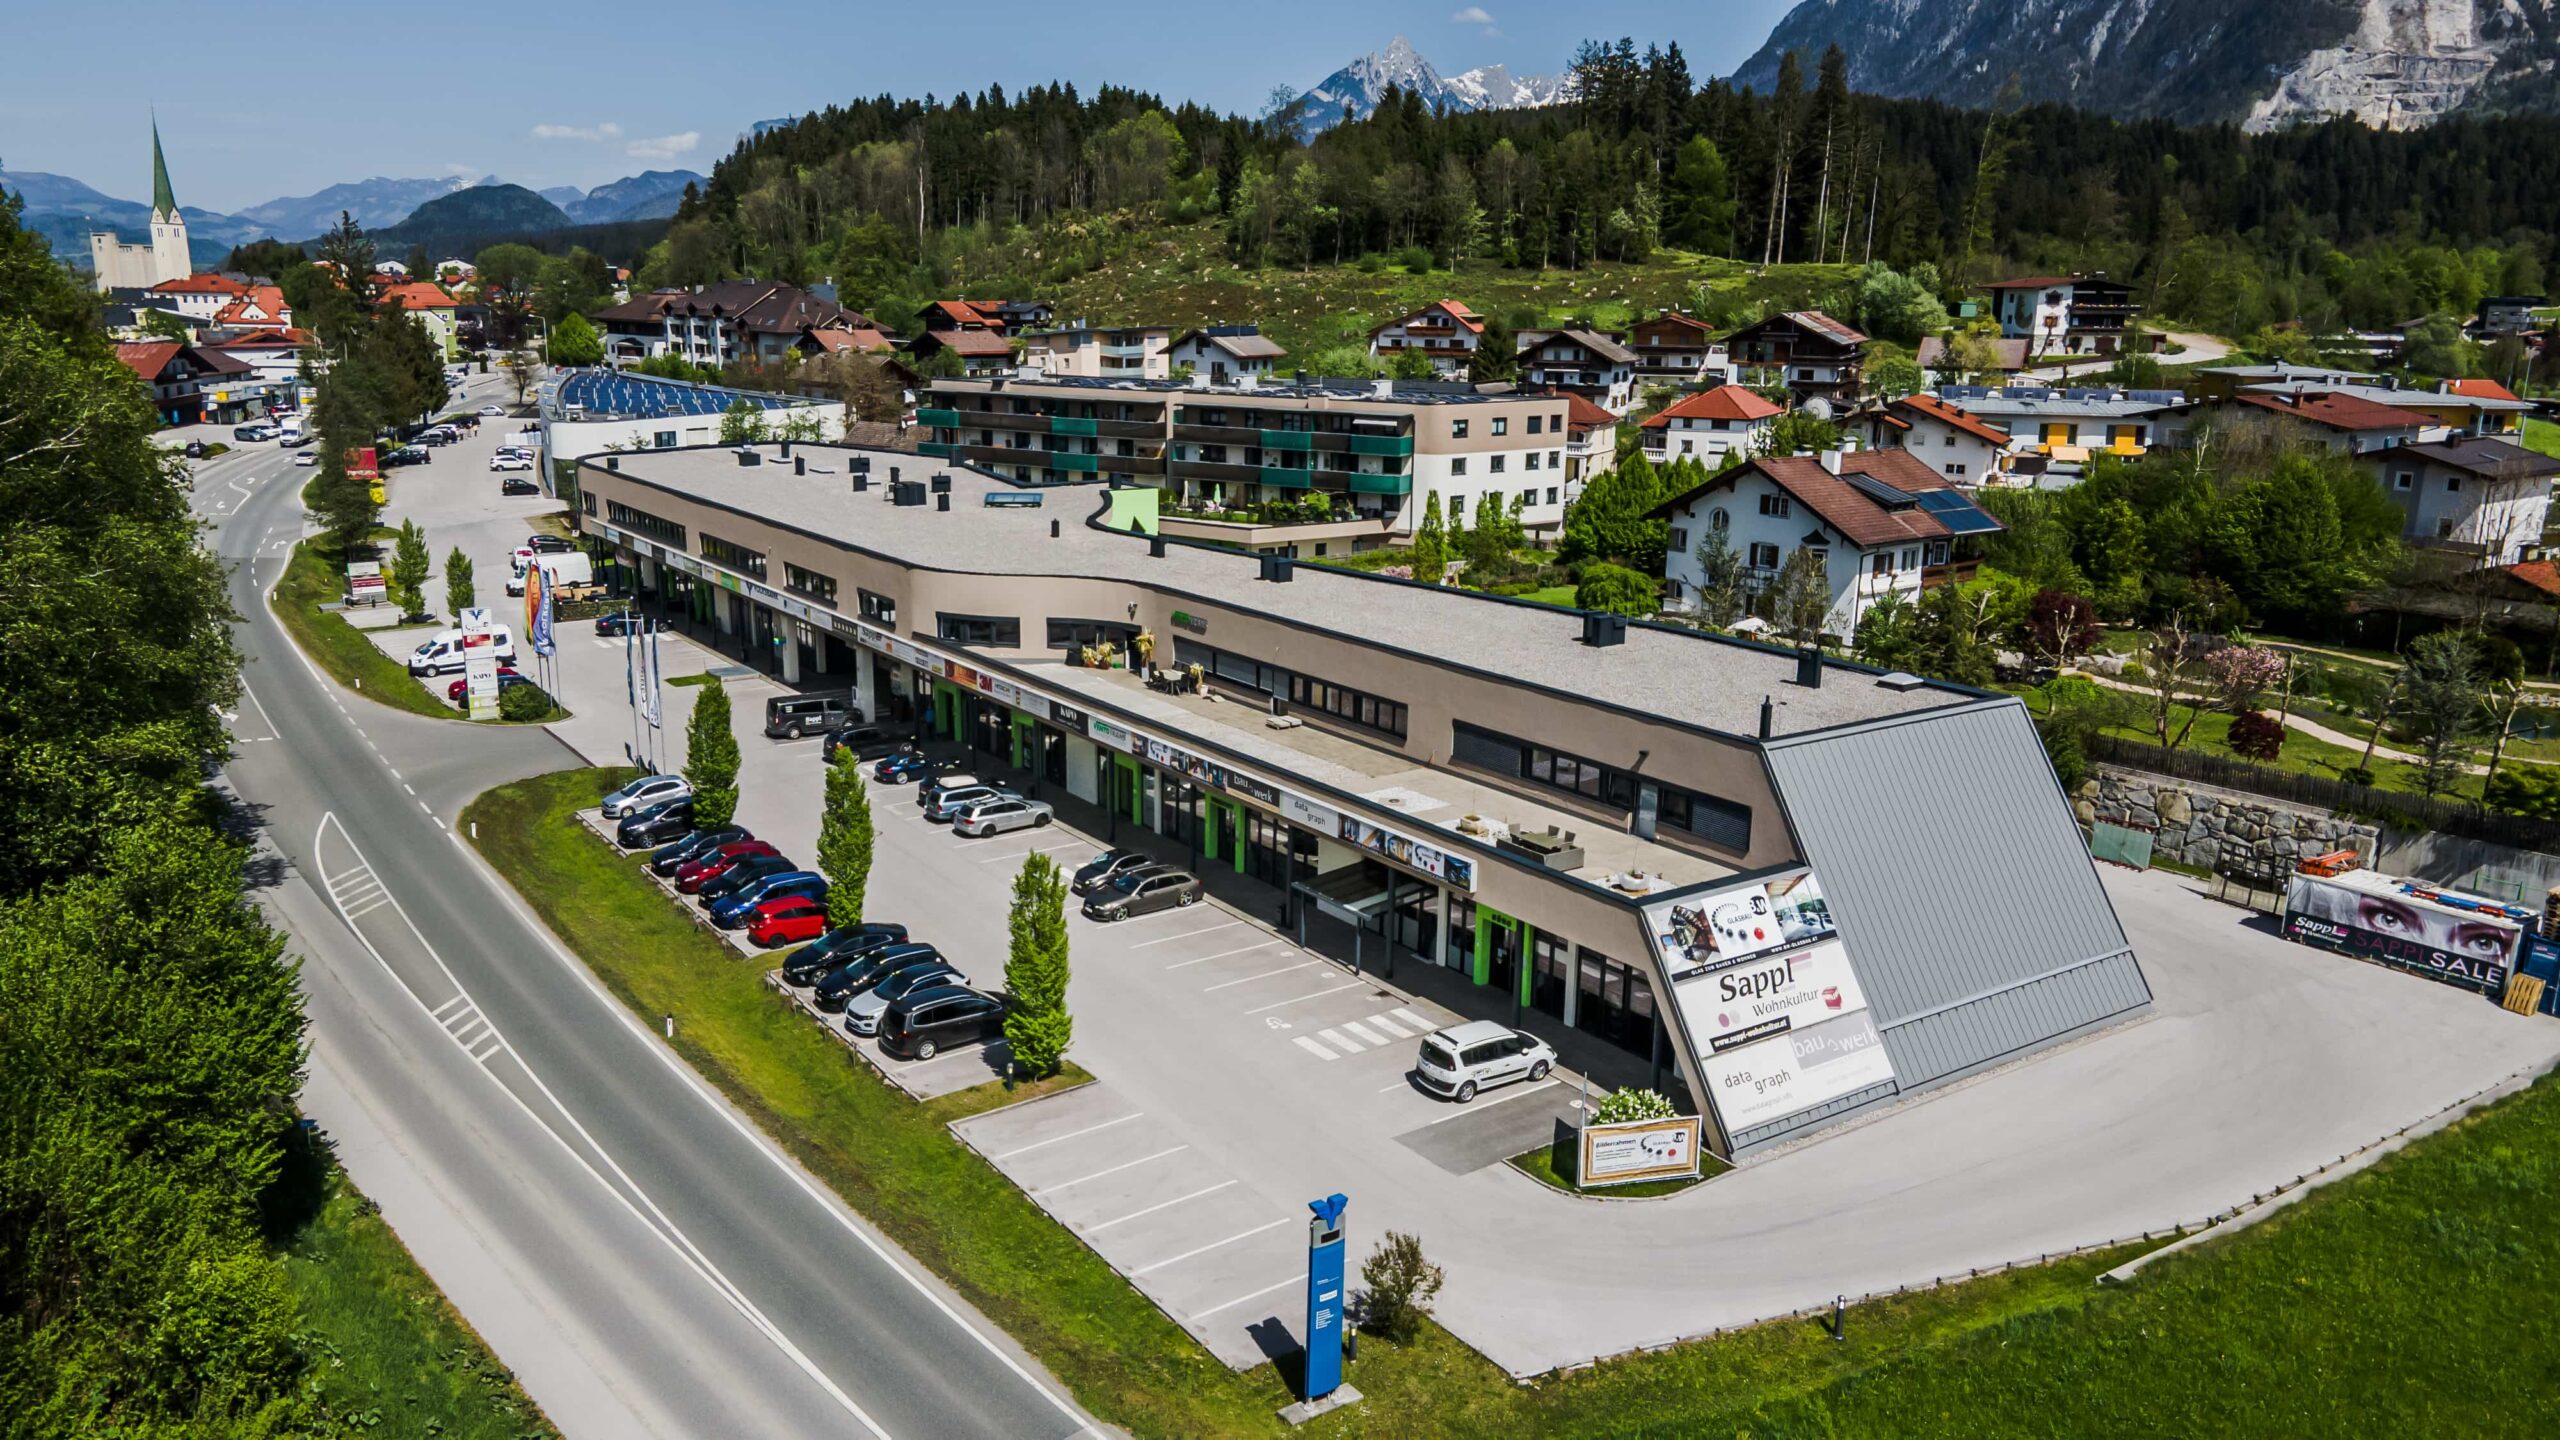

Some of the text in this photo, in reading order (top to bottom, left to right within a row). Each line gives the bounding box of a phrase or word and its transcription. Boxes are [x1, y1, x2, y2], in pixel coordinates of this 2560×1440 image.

[979, 675, 993, 692] 3M
[1233, 773, 1248, 788] bau
[1254, 789, 1272, 803] werk
[1294, 800, 1308, 812] data
[1307, 812, 1326, 826] graph
[1727, 912, 1753, 924] GLASBAU
[2295, 916, 2339, 935] Sappl
[2430, 952, 2502, 984] SALE
[1719, 958, 1794, 1002] Sappl
[1752, 988, 1819, 1017] Wohnkultur
[1838, 1022, 1880, 1051] werk
[1791, 1034, 1825, 1058] bau
[1725, 1070, 1752, 1088] data
[1754, 1069, 1792, 1095] graph
